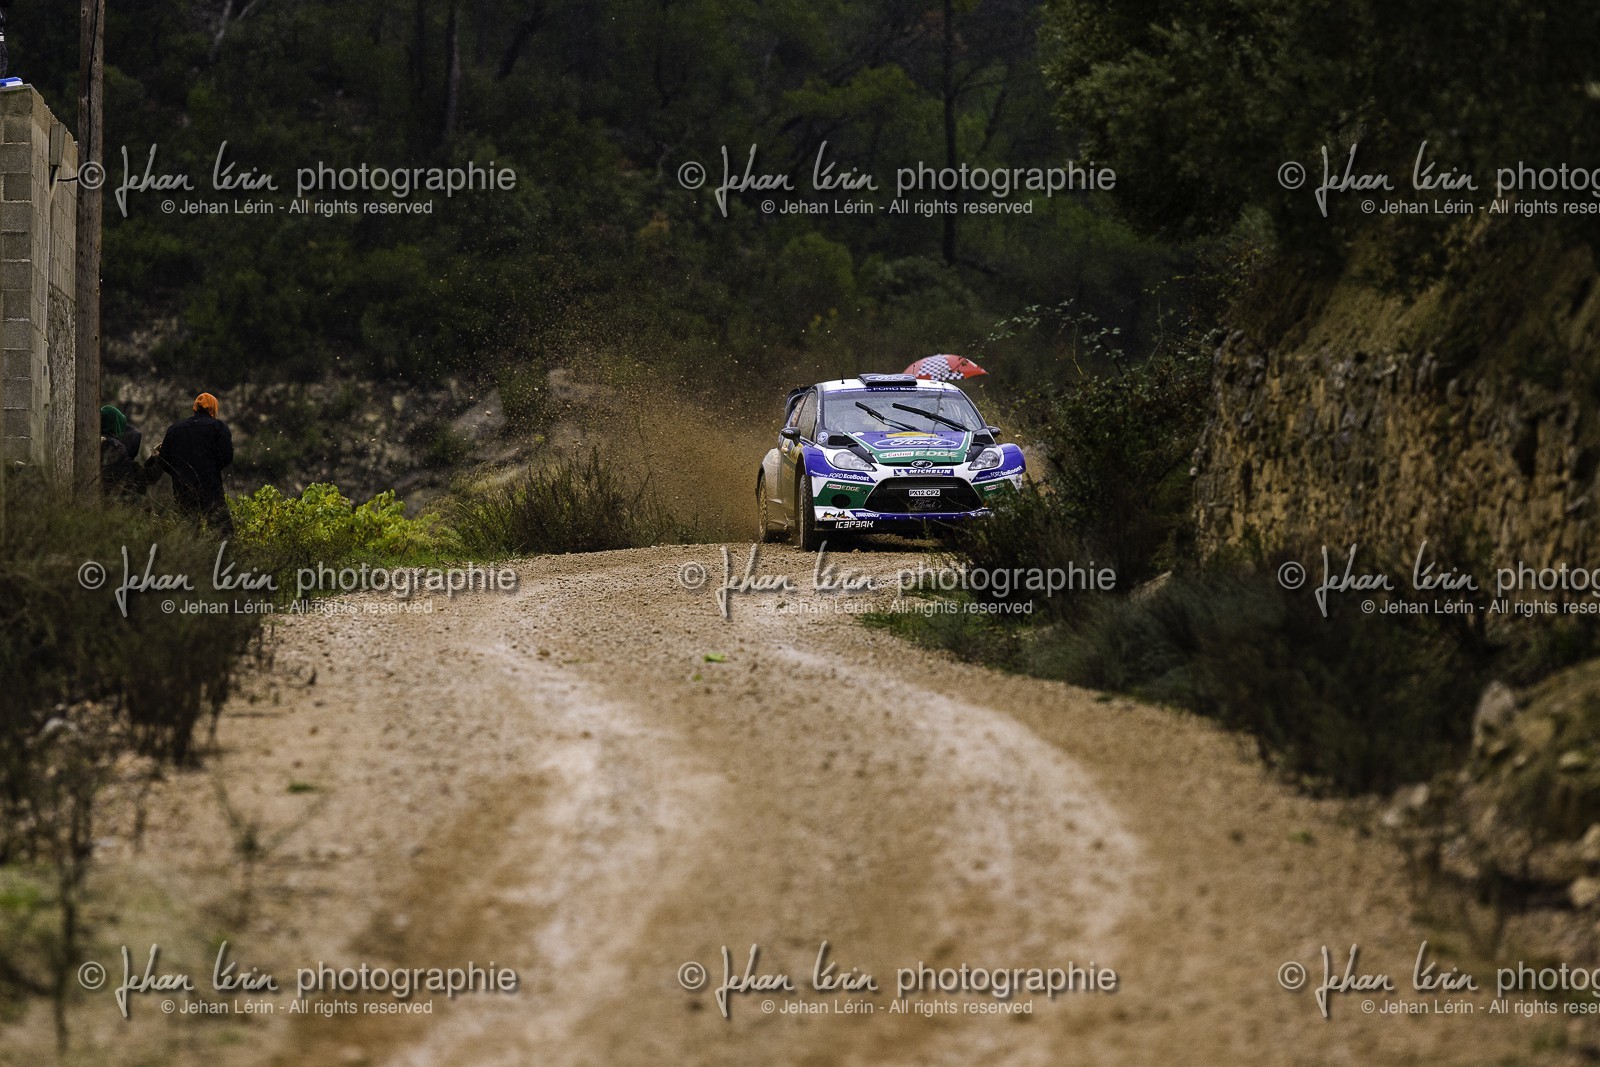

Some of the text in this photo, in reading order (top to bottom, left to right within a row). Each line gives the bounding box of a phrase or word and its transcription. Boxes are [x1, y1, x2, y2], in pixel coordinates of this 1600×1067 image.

[890, 438, 942, 446] Ford
[914, 450, 958, 458] EDGE
[843, 473, 870, 482] EcoBoost
